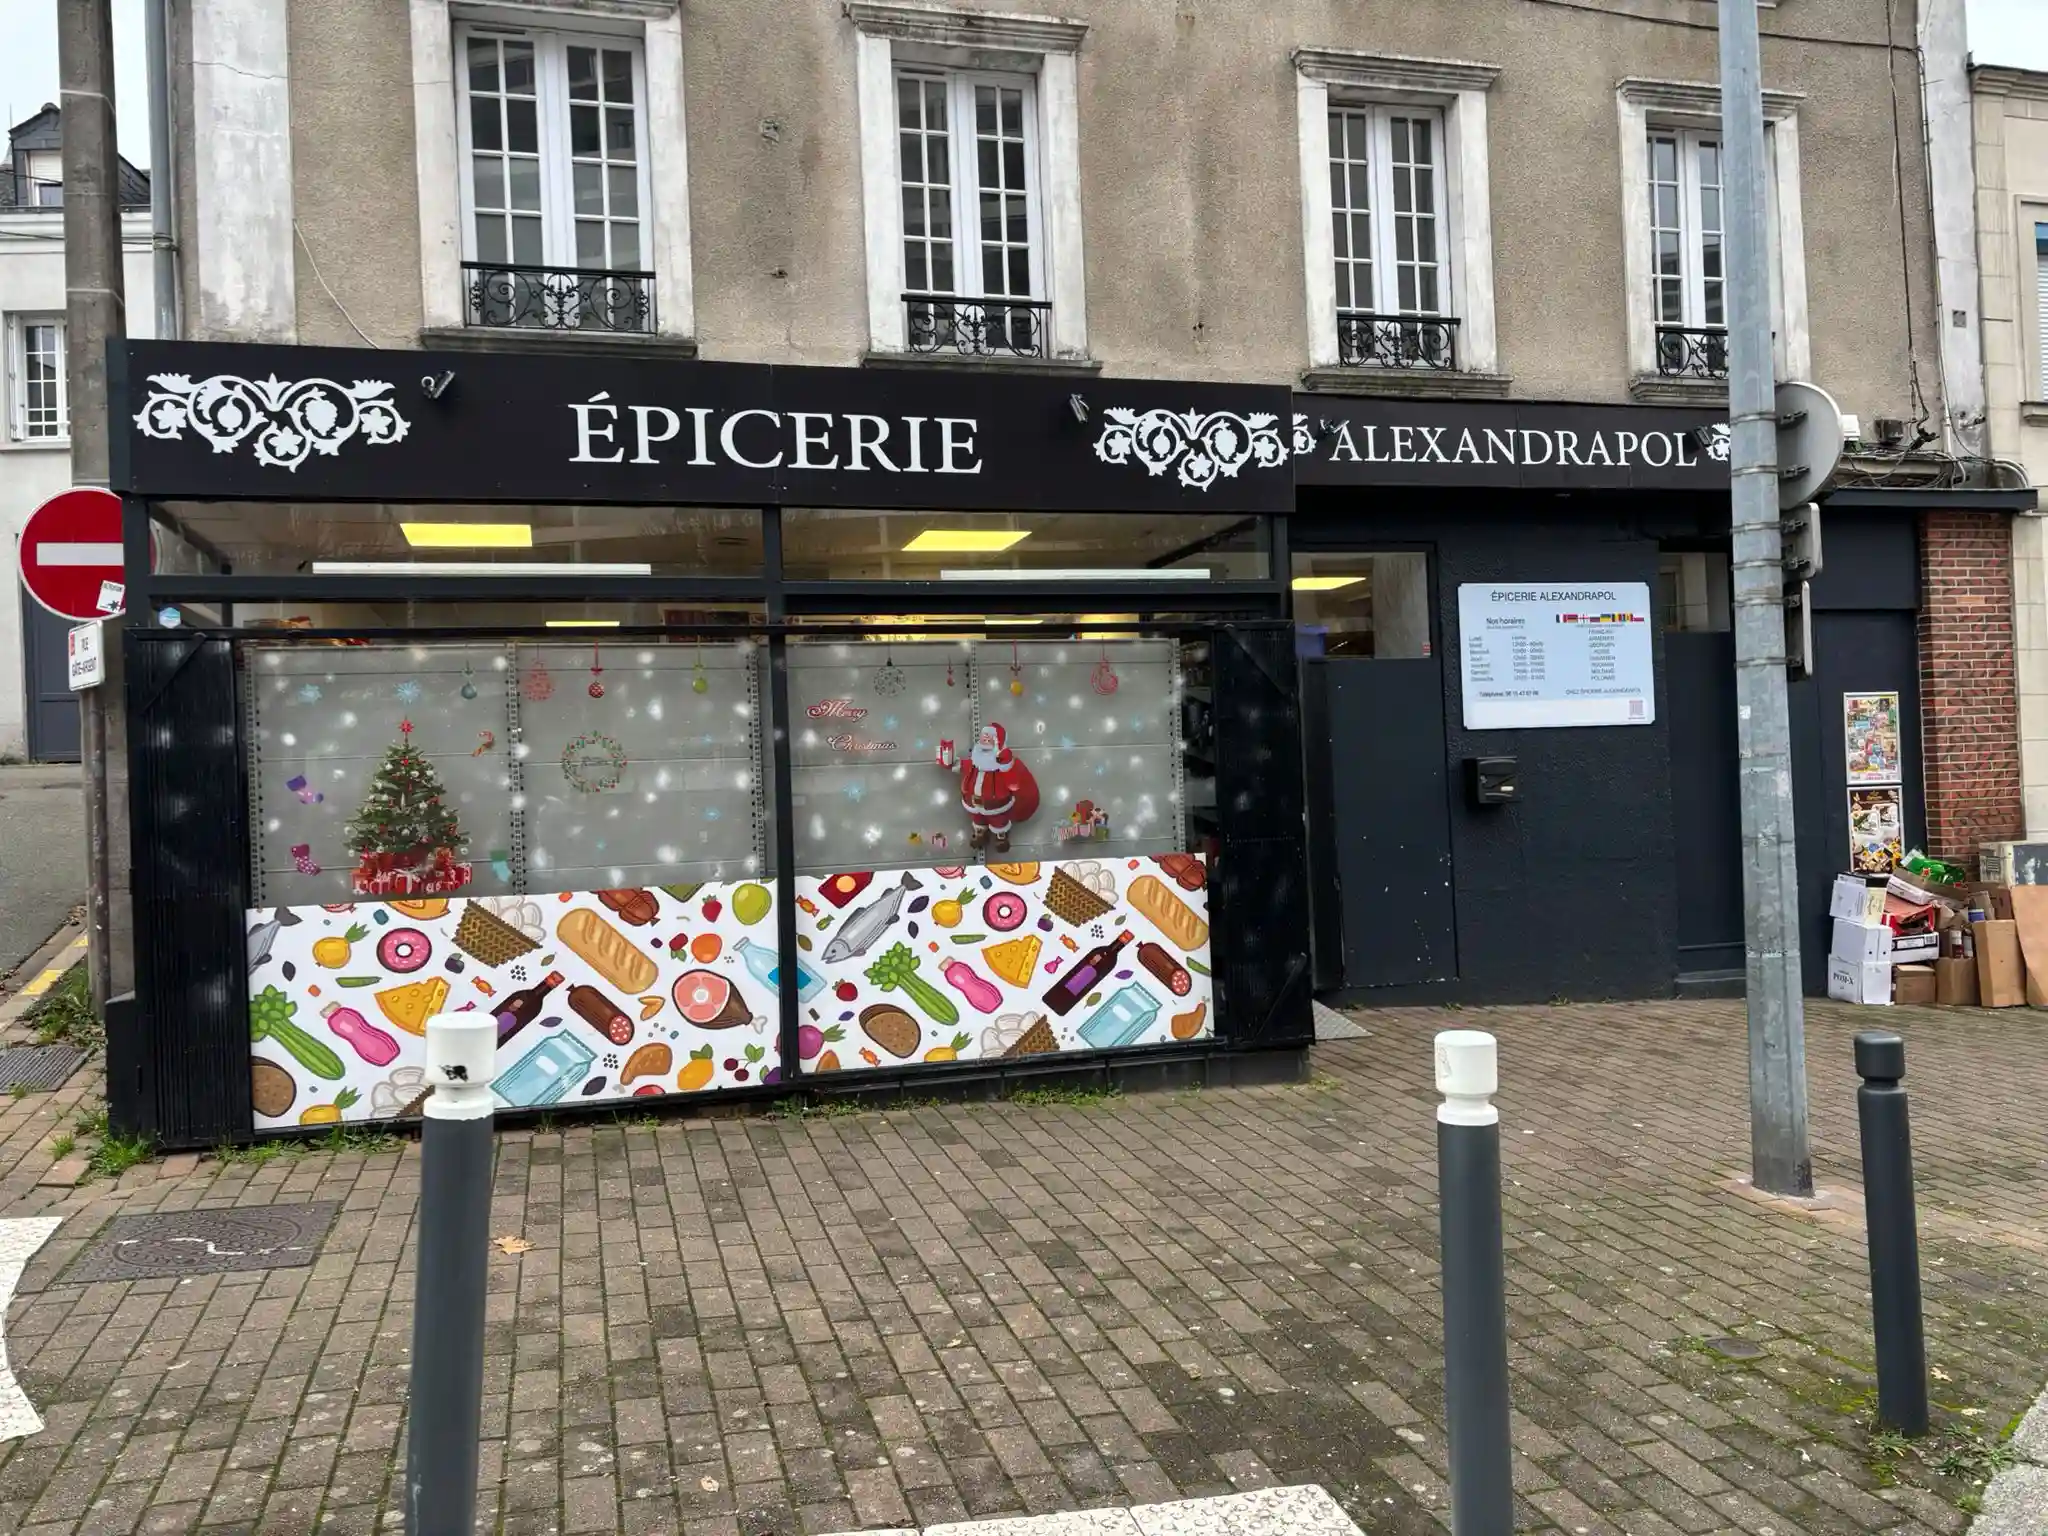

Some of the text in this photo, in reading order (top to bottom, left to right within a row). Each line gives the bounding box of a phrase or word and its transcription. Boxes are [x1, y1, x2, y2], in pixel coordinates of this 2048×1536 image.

[567, 390, 983, 475] ÉPICERIE
[1328, 420, 1699, 468] ALEXANDRAPOL
[1491, 590, 1617, 602] ÉPICERIE ALEXANDRAPOL
[806, 699, 868, 722] Merry
[826, 733, 898, 752] Christmas
